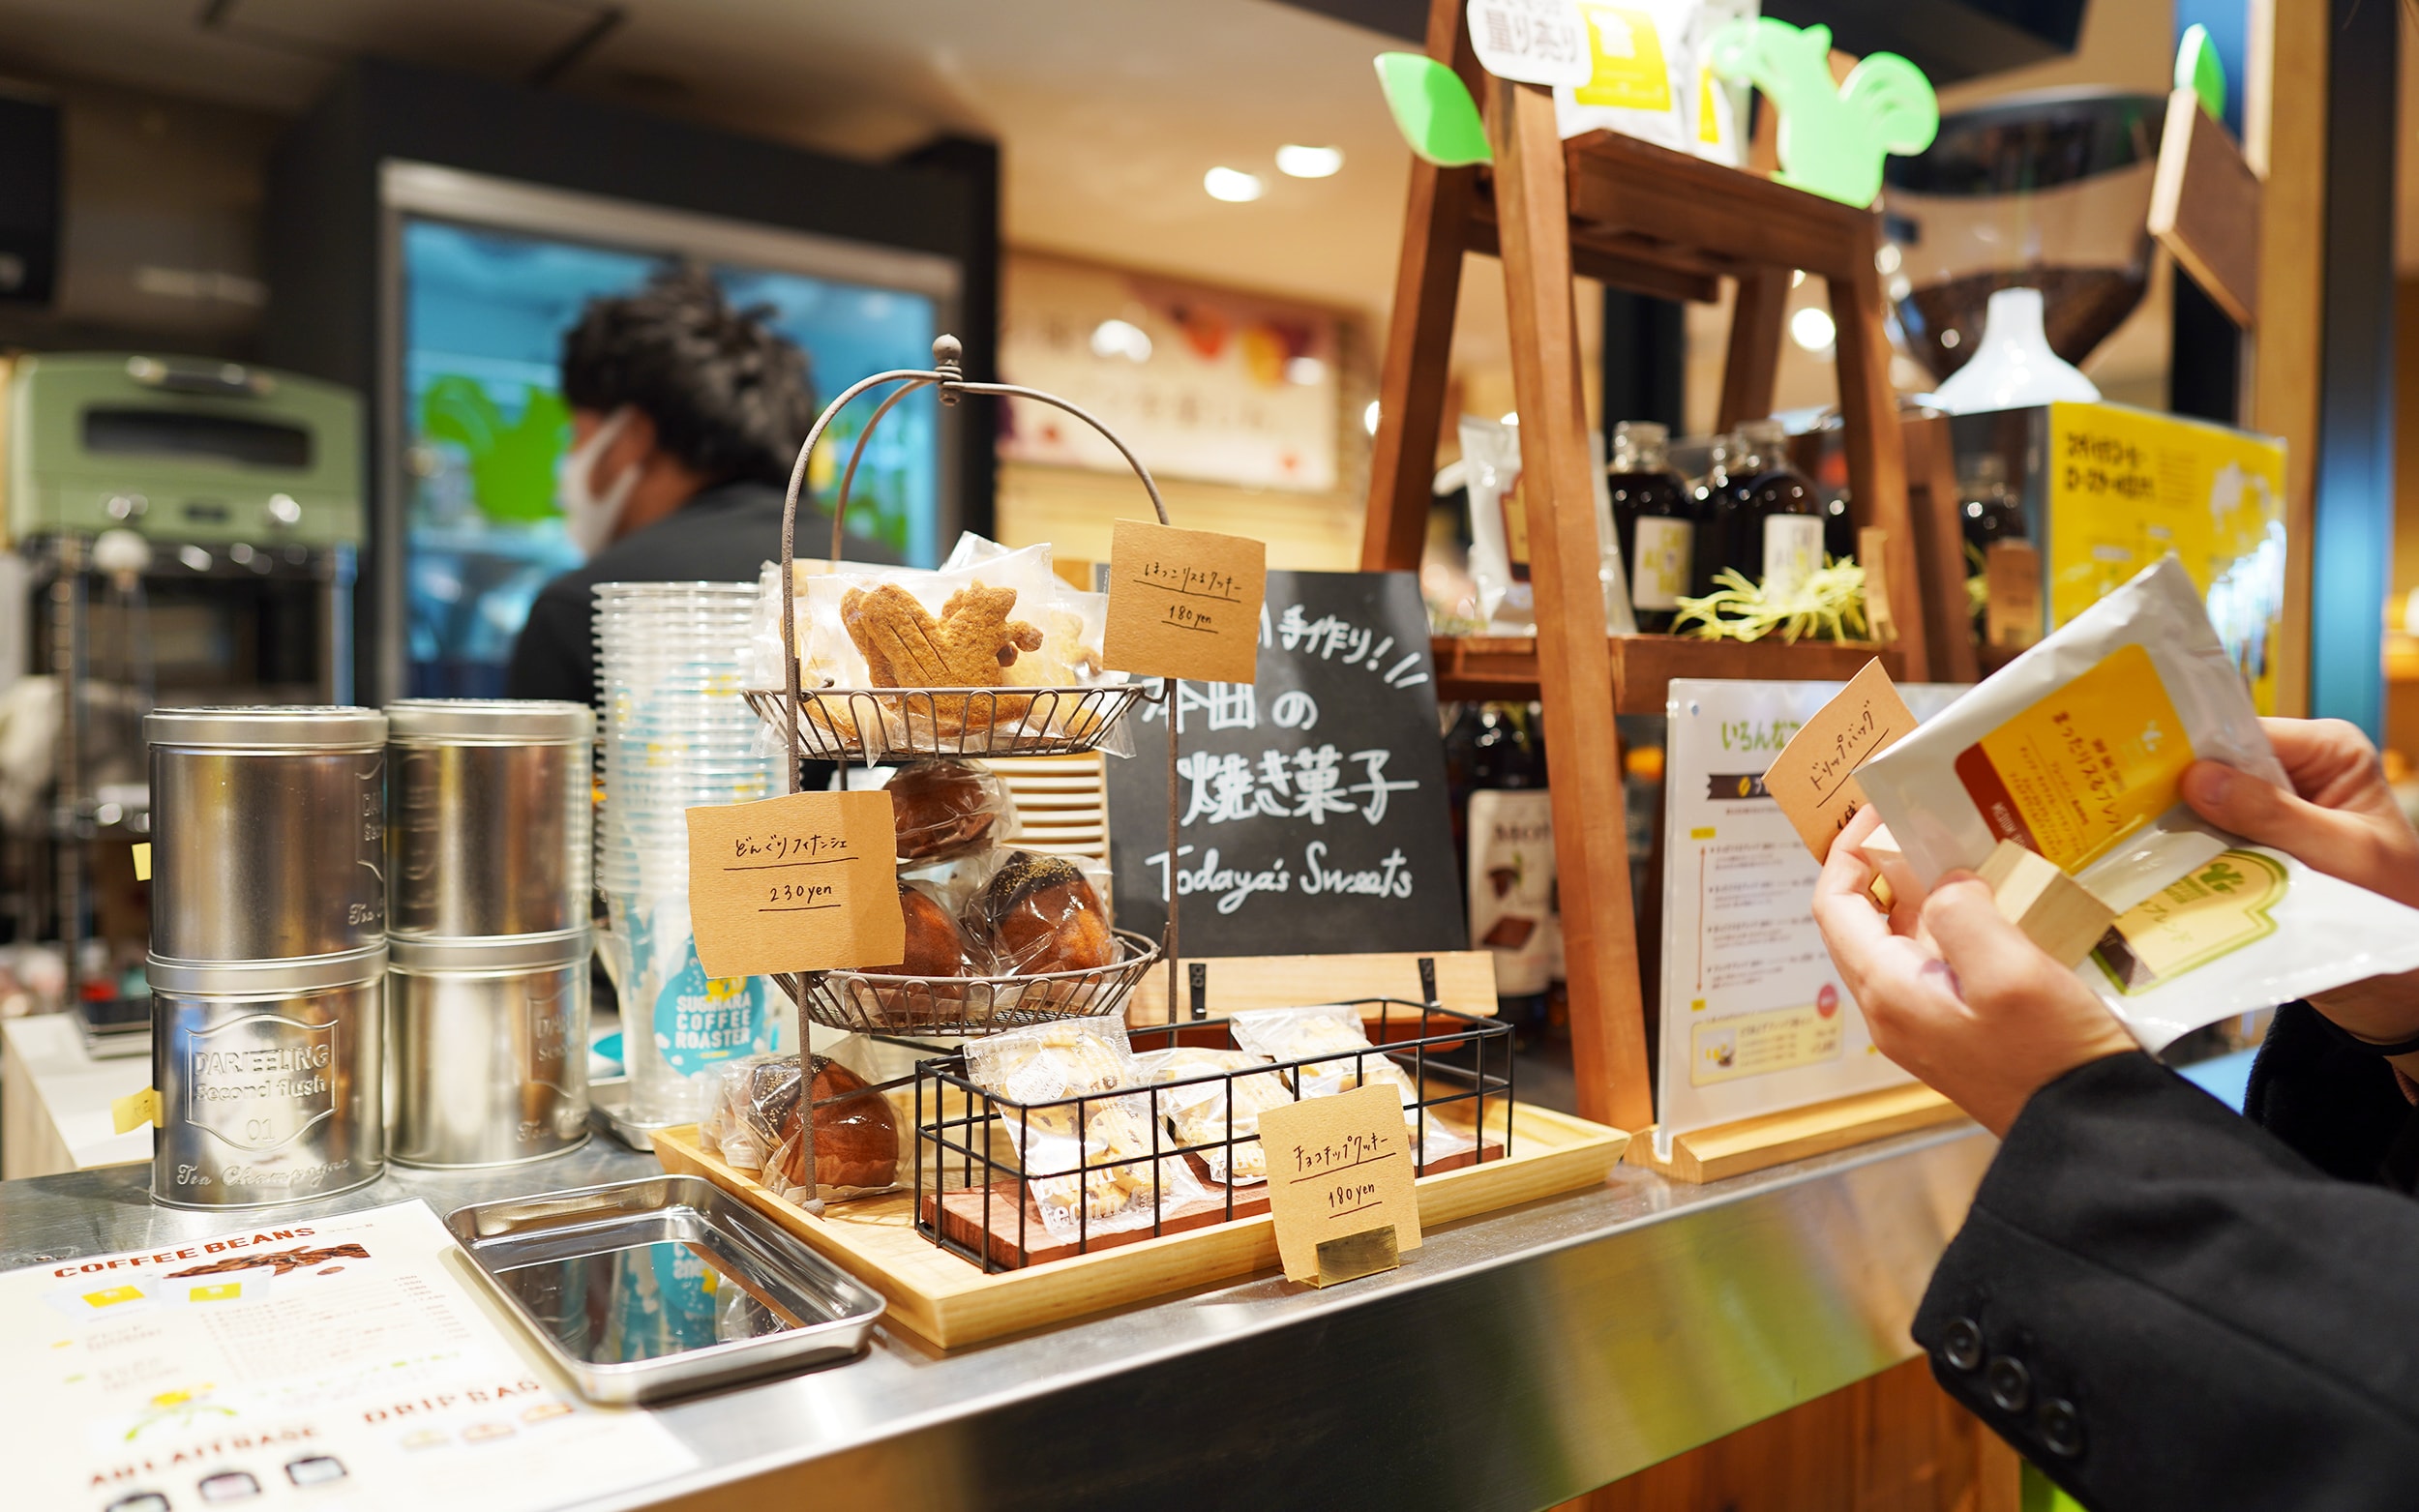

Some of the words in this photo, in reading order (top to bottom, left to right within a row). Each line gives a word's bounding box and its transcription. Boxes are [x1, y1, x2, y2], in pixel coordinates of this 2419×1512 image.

[1177, 743, 1419, 826] 焼き菓子
[1299, 841, 1413, 898] Sweets
[676, 1009, 751, 1031] COFFEE
[674, 1026, 751, 1050] ROASTER
[194, 1044, 330, 1076] DARJEELING
[246, 1117, 276, 1143] 01
[53, 1246, 198, 1279] COFFEE
[203, 1227, 316, 1255] BEANS
